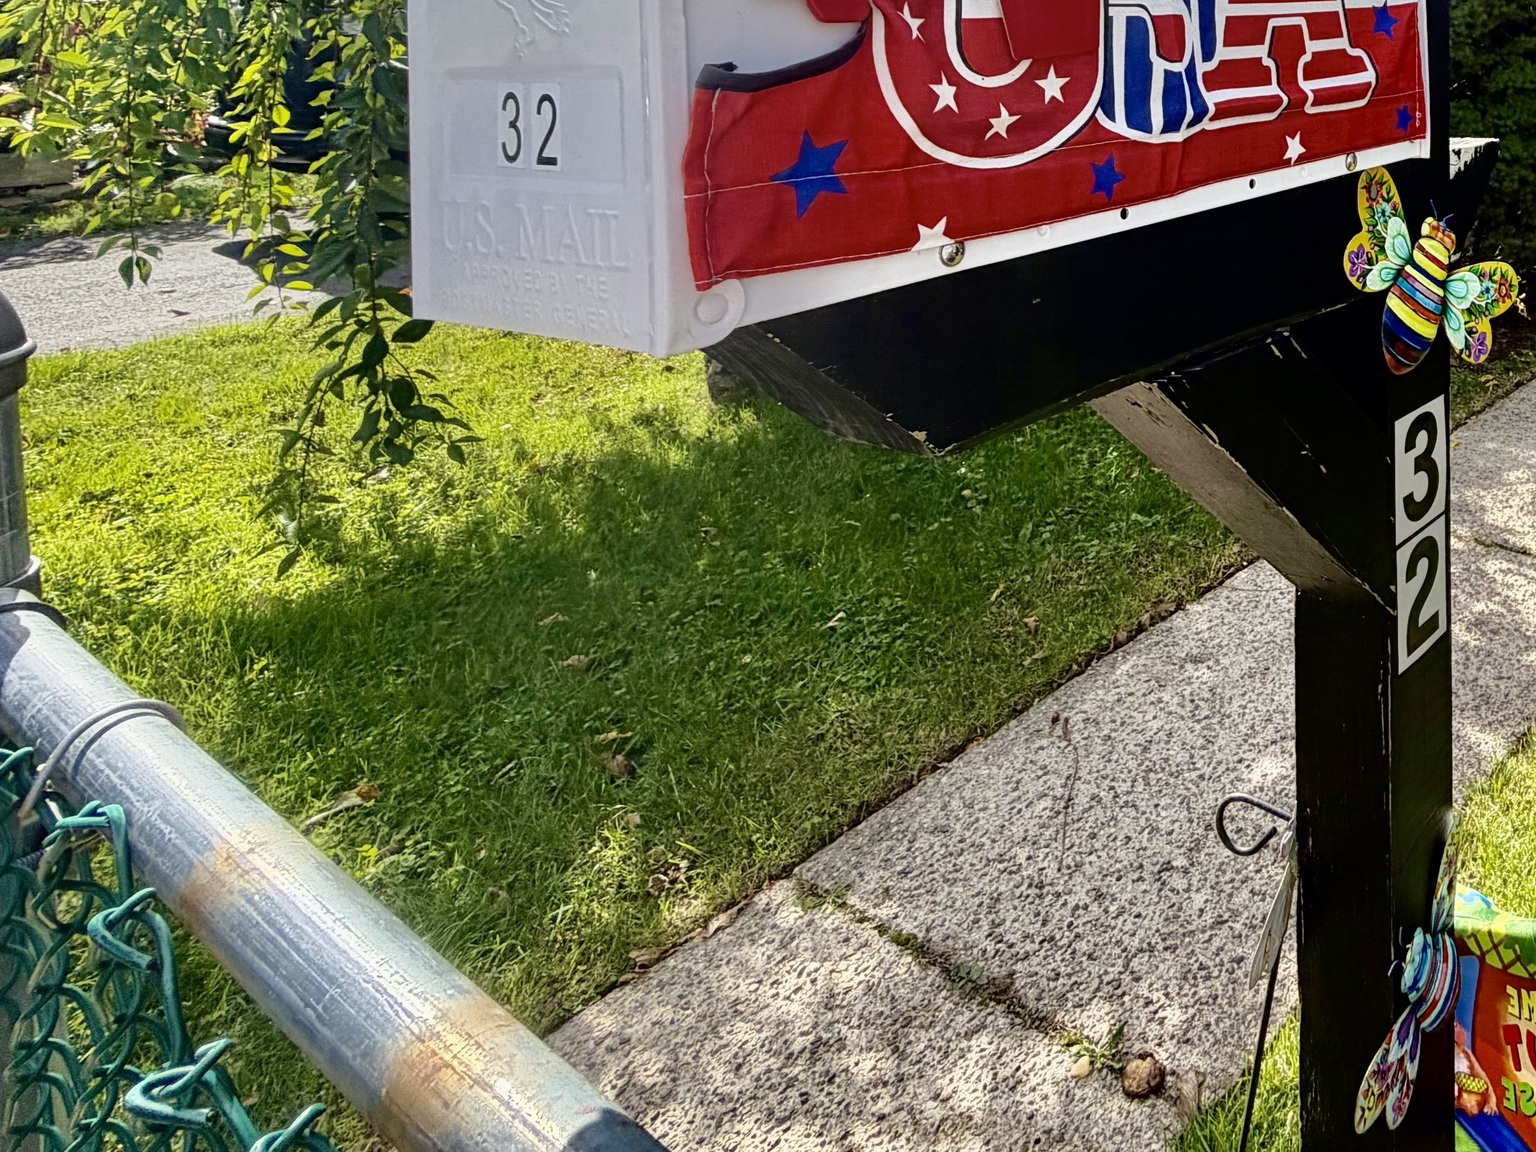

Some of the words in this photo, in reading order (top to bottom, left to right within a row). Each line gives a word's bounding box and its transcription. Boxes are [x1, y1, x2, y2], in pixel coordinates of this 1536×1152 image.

[500, 90, 559, 167] 32
[439, 198, 503, 258] U.S.
[514, 201, 631, 271] MAIL
[1402, 410, 1440, 659] 32
